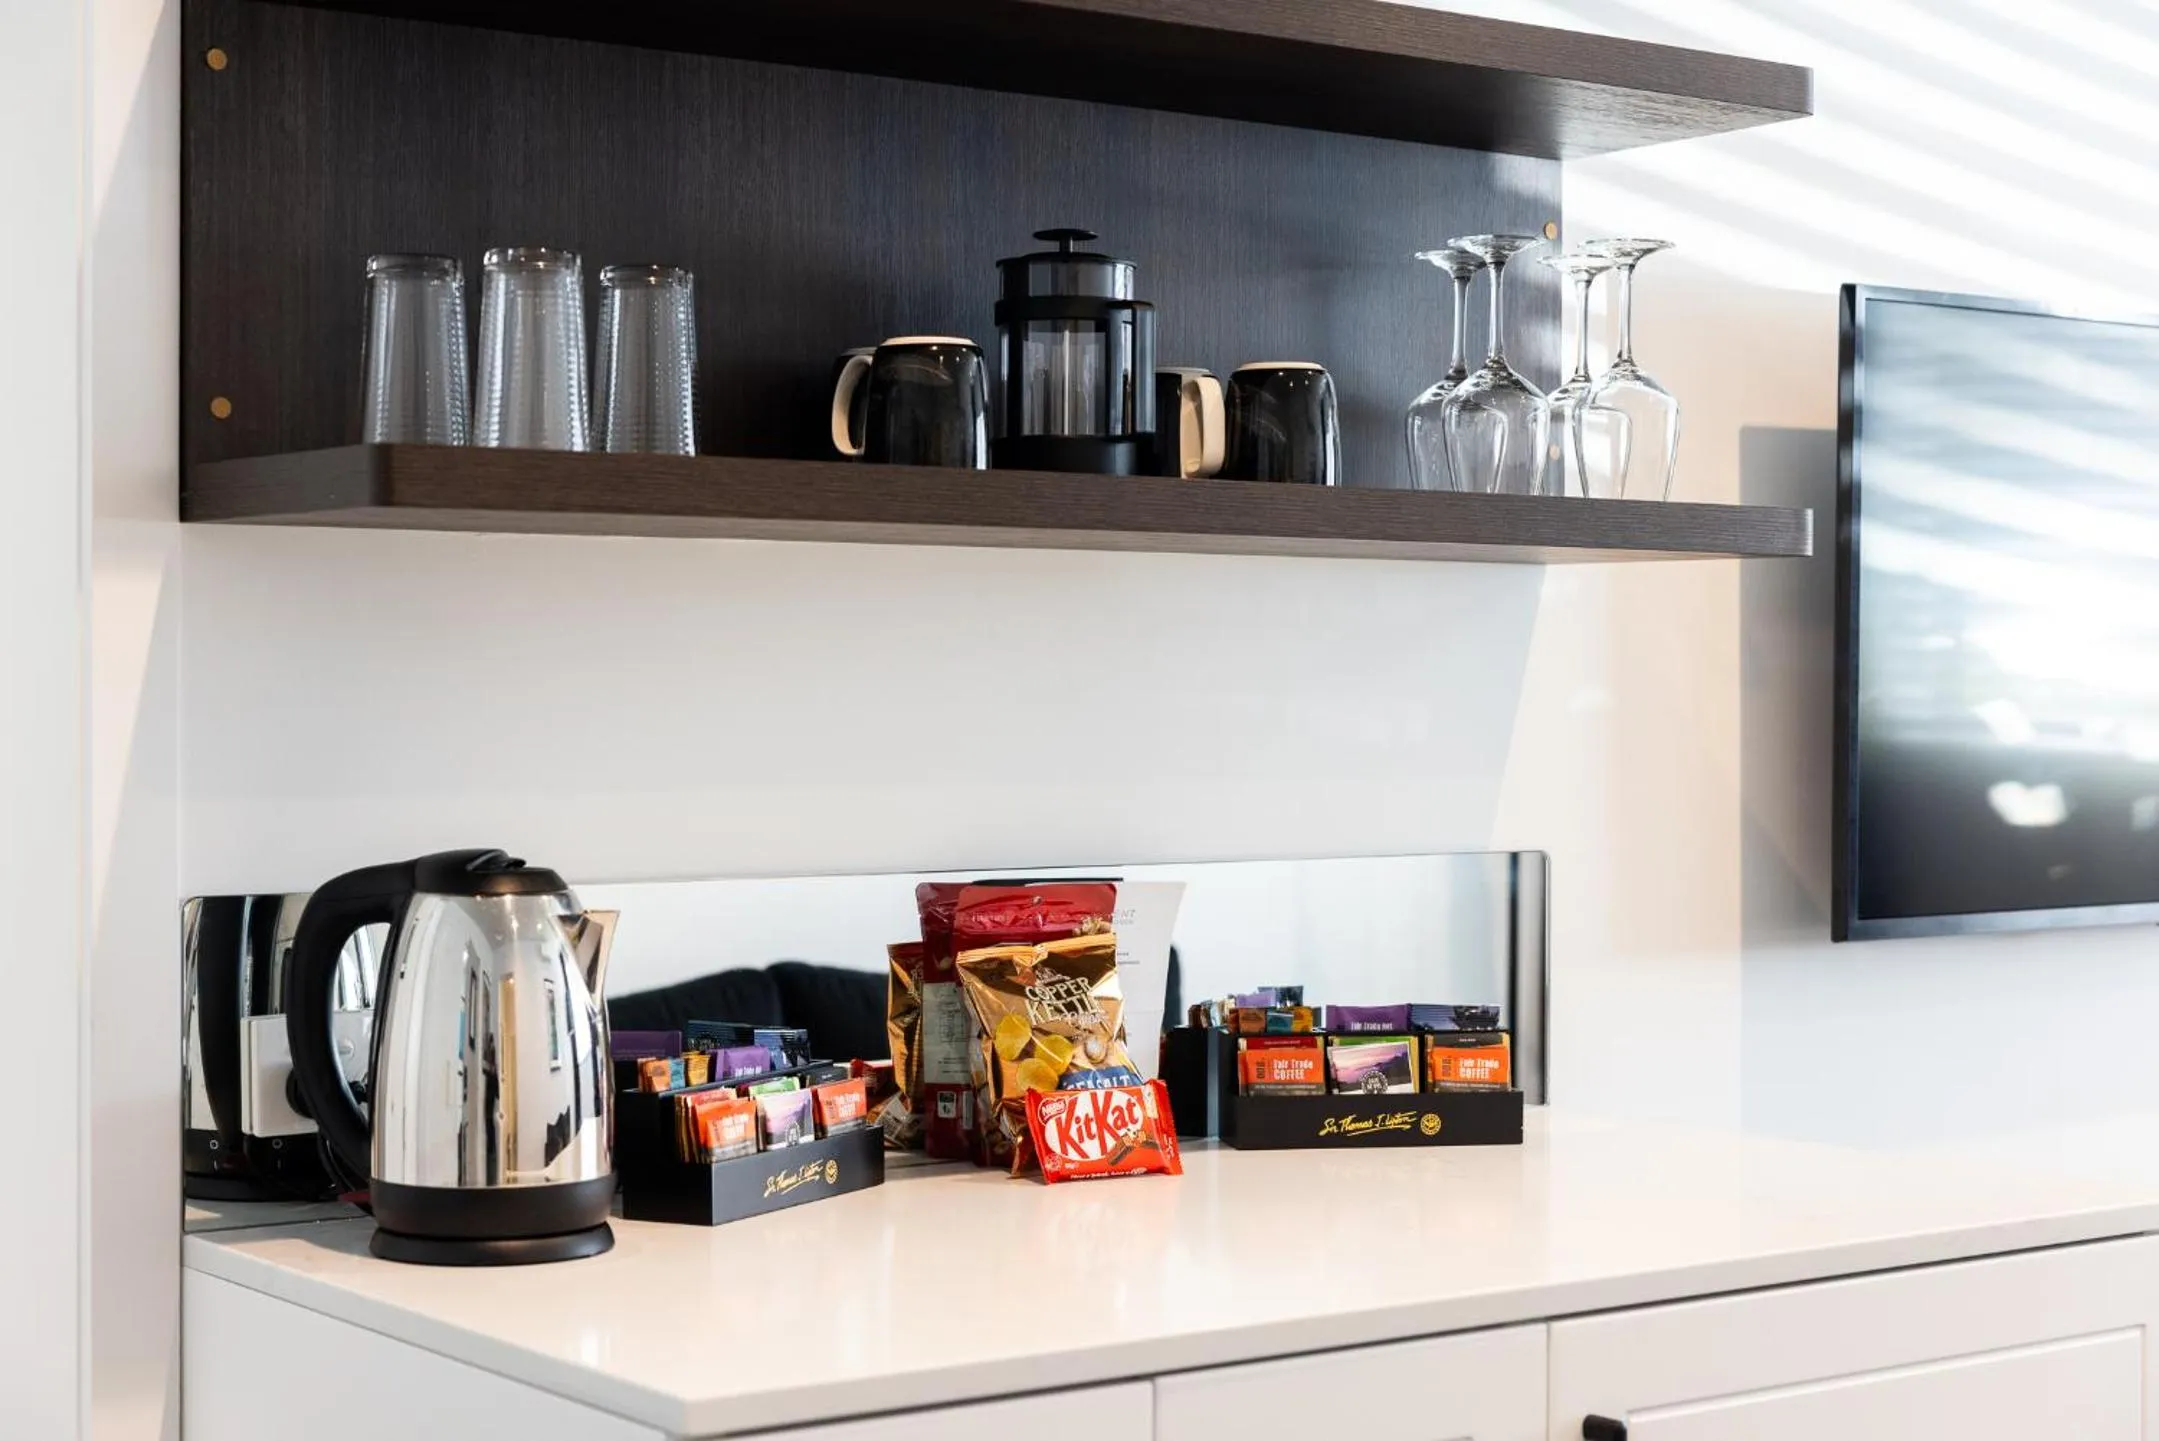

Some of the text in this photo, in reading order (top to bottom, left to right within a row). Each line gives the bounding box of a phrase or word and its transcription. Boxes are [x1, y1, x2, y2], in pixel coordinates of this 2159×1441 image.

[1025, 977, 1092, 1001] COPPER
[1273, 1069, 1305, 1080] COFFEE
[1055, 1090, 1140, 1160] KitKat
